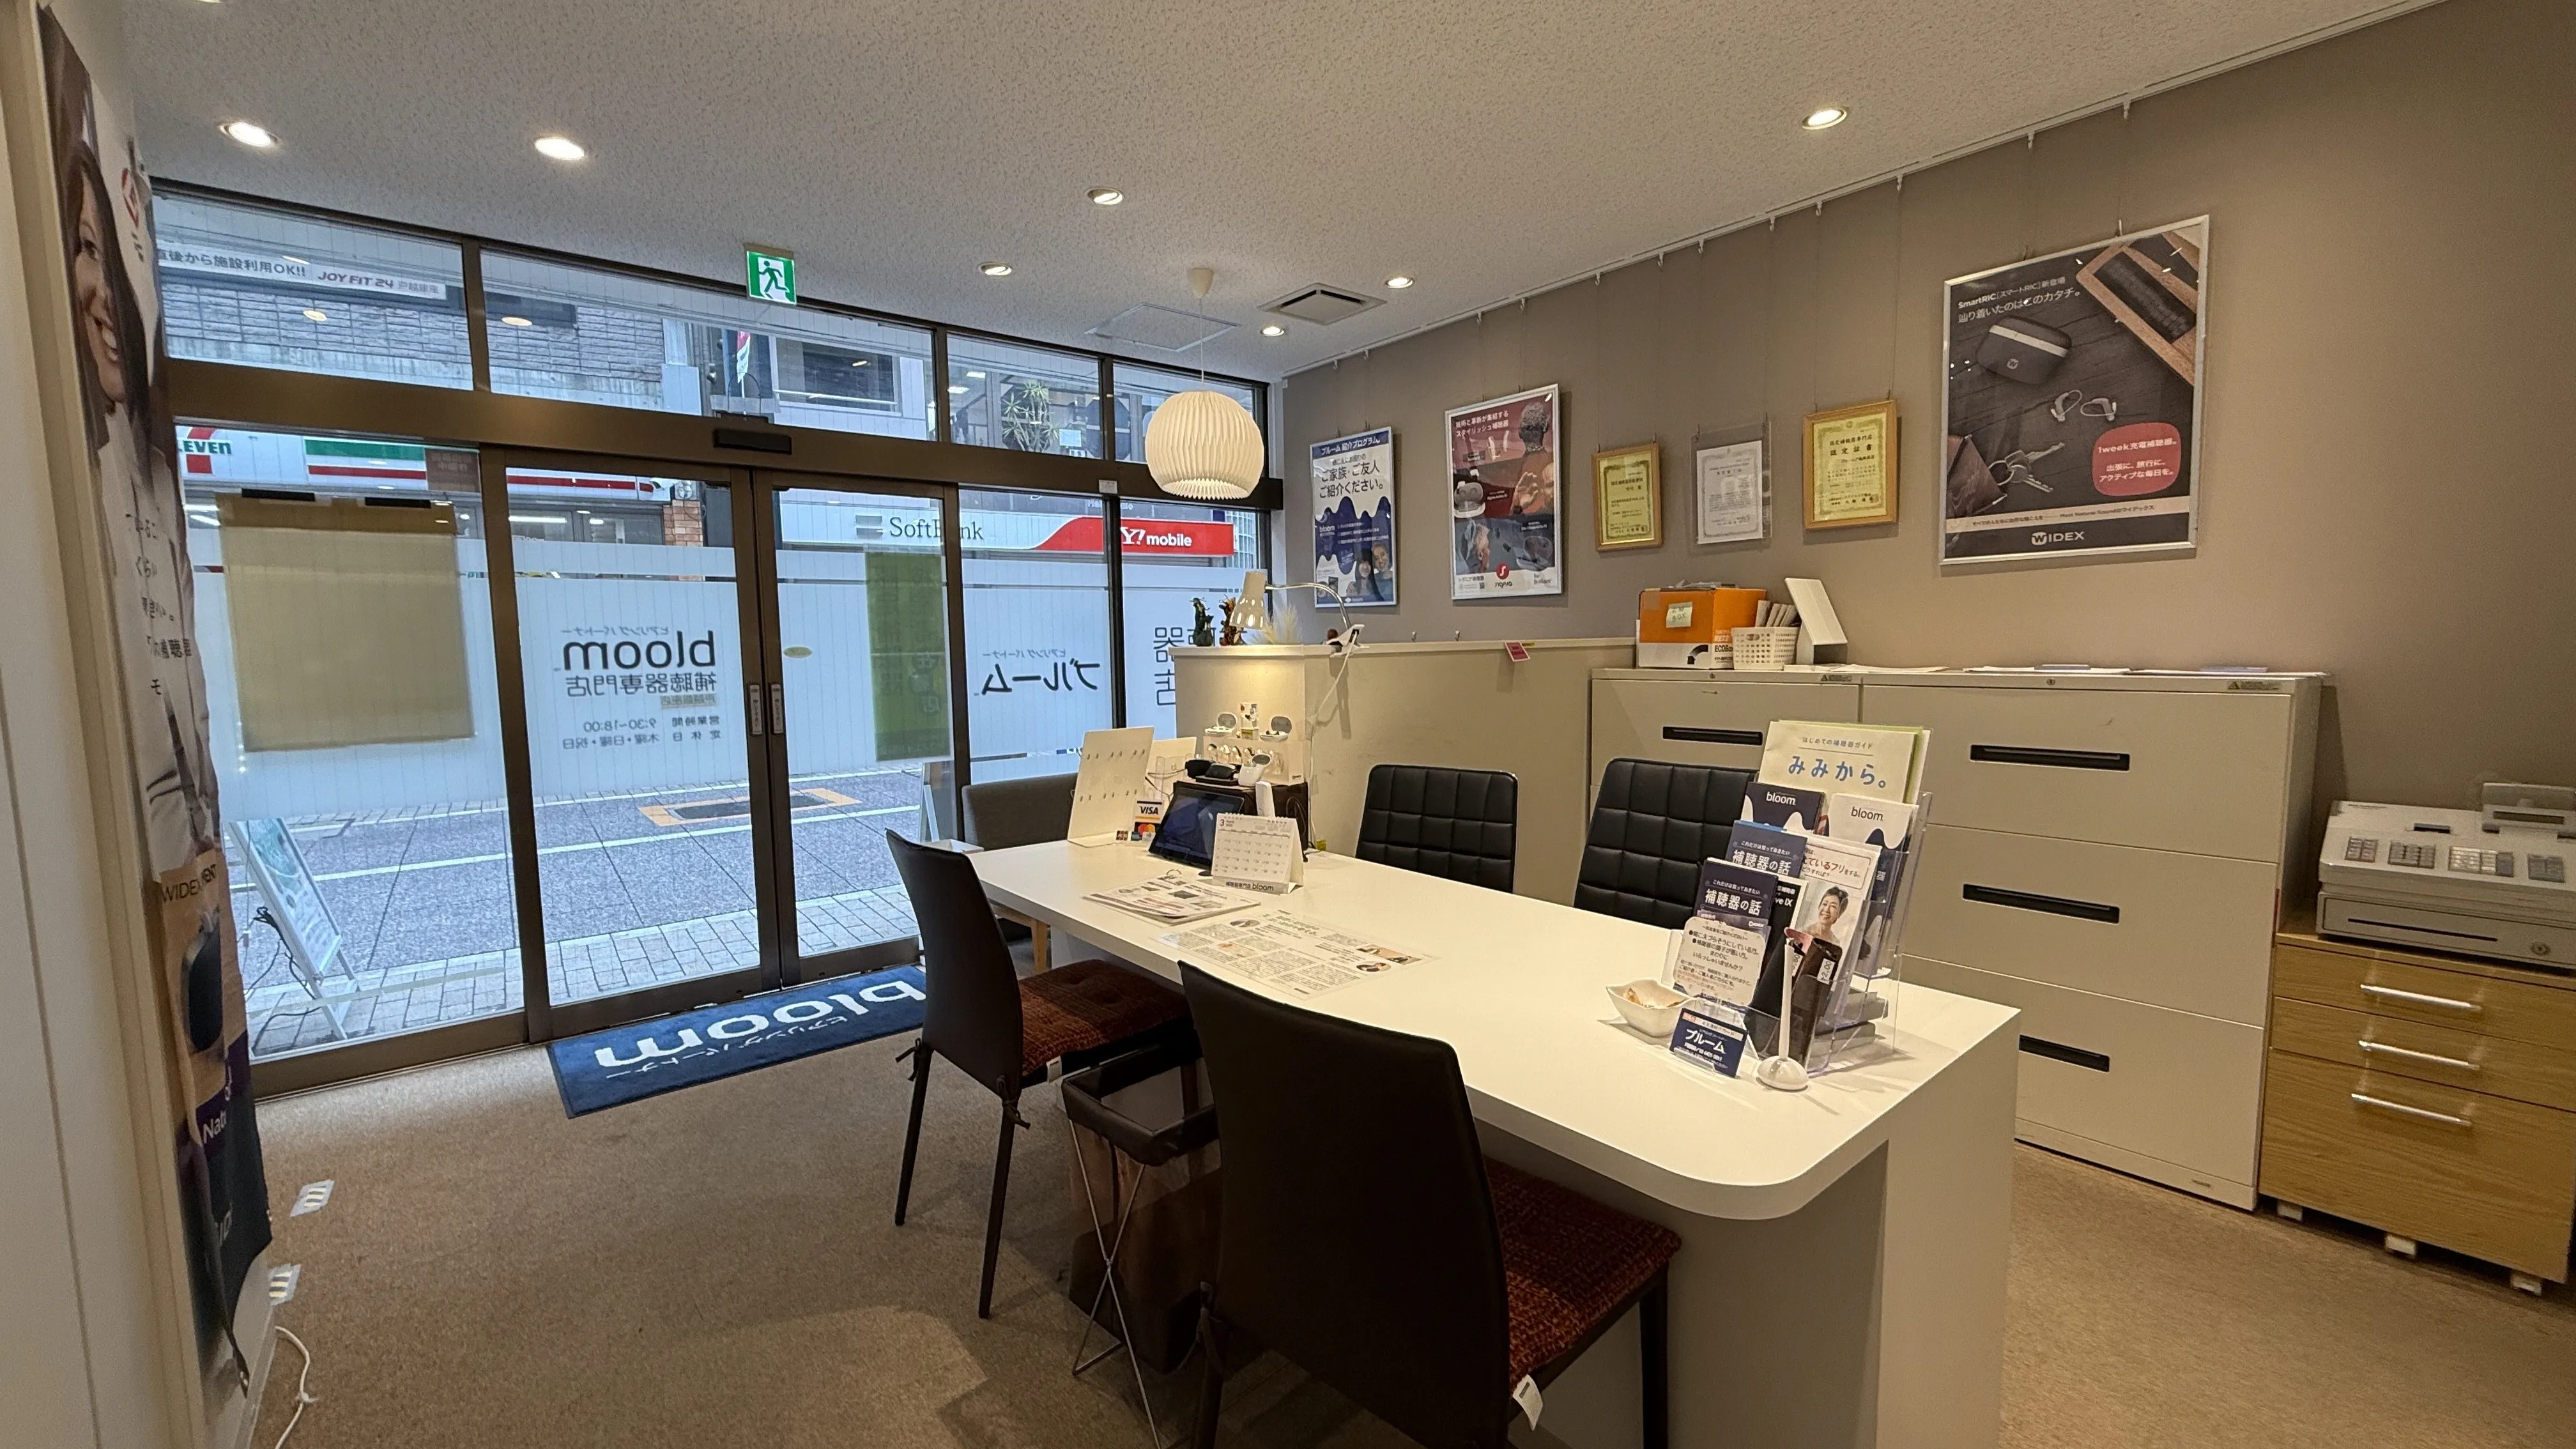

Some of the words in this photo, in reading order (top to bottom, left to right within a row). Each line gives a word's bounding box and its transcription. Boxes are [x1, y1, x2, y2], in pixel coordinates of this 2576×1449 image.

[2031, 530, 2085, 545] WIDEX
[1802, 737, 1874, 749] はじめての補聴器ガイド
[1788, 755, 1887, 788] みみから。
[1766, 792, 1797, 806] bloom
[1139, 806, 1159, 815] VISA
[1850, 806, 1883, 822] bloom
[1252, 882, 1274, 892] bloom
[1705, 889, 1763, 917] 補聴器の話
[594, 980, 926, 1068] bloom
[1685, 1028, 1727, 1054] ブルーム
